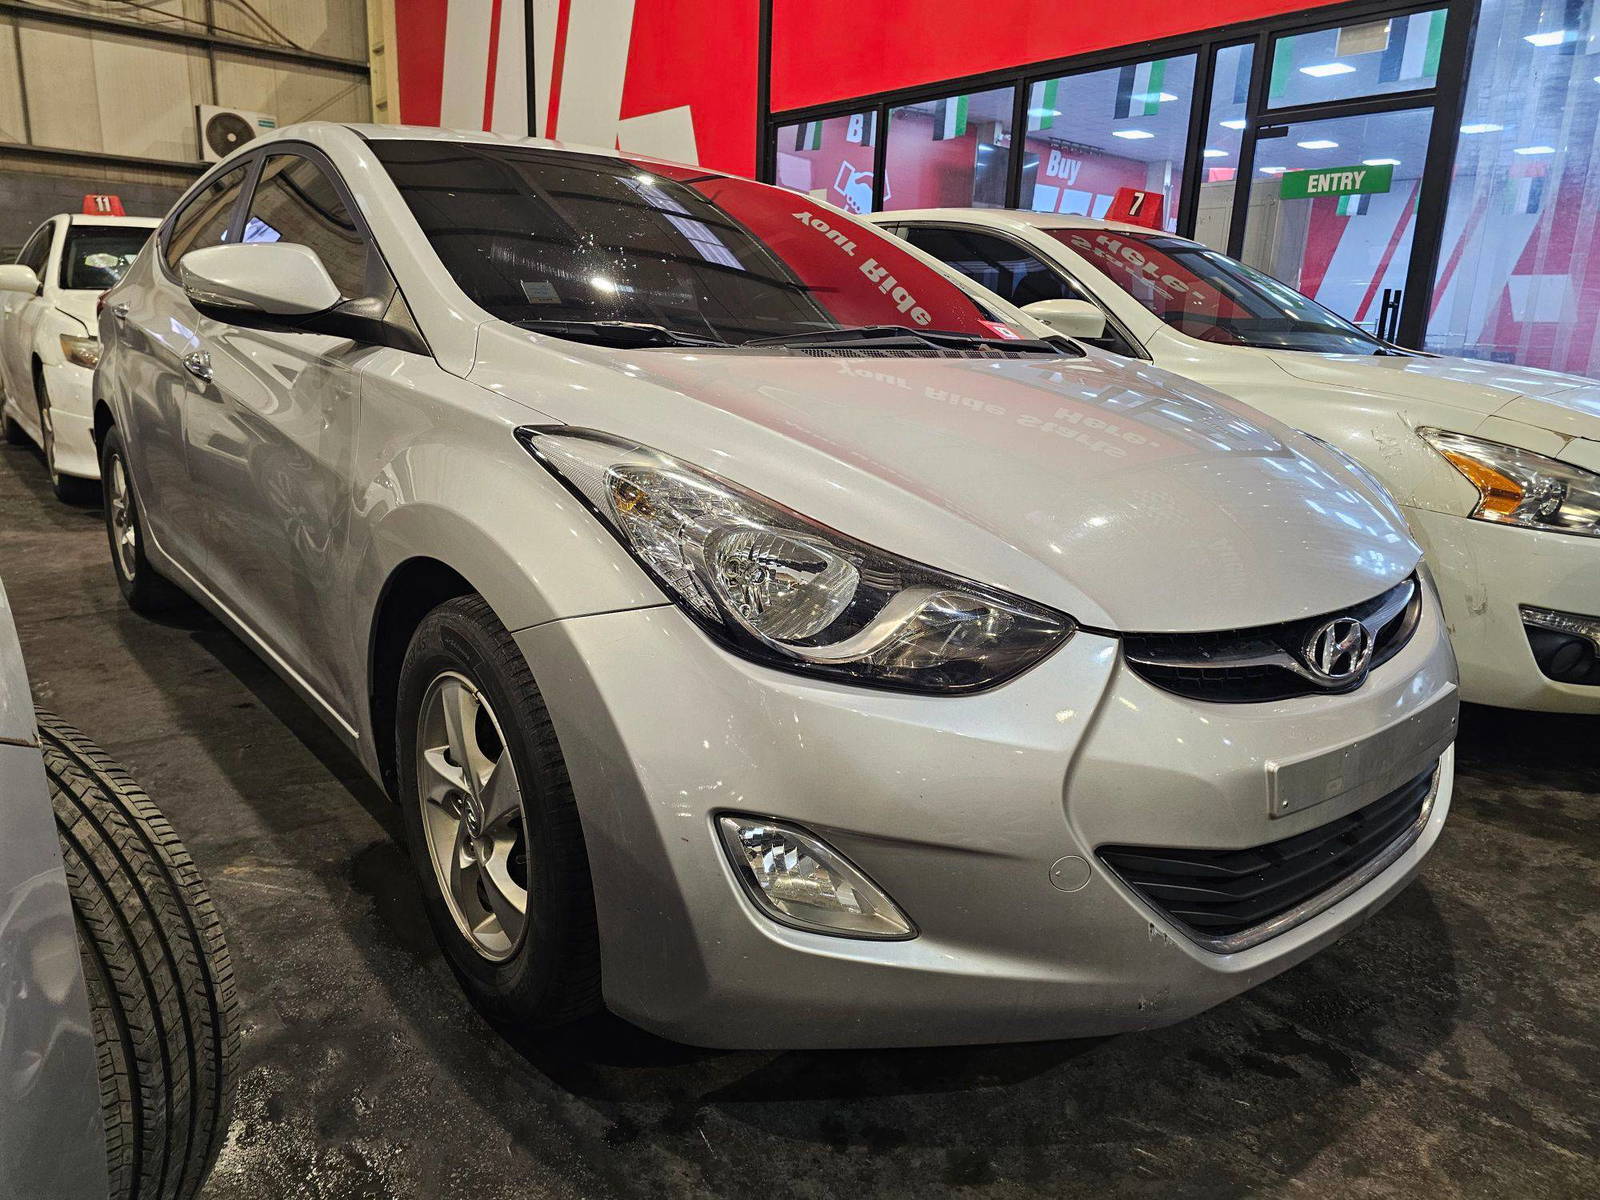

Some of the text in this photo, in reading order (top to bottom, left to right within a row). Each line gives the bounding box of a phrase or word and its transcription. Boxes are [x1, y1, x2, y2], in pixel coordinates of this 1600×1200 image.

[1046, 149, 1081, 185] Buy
[1307, 170, 1366, 193] ENTRY
[95, 195, 112, 212] 11
[1129, 192, 1145, 216] 7
